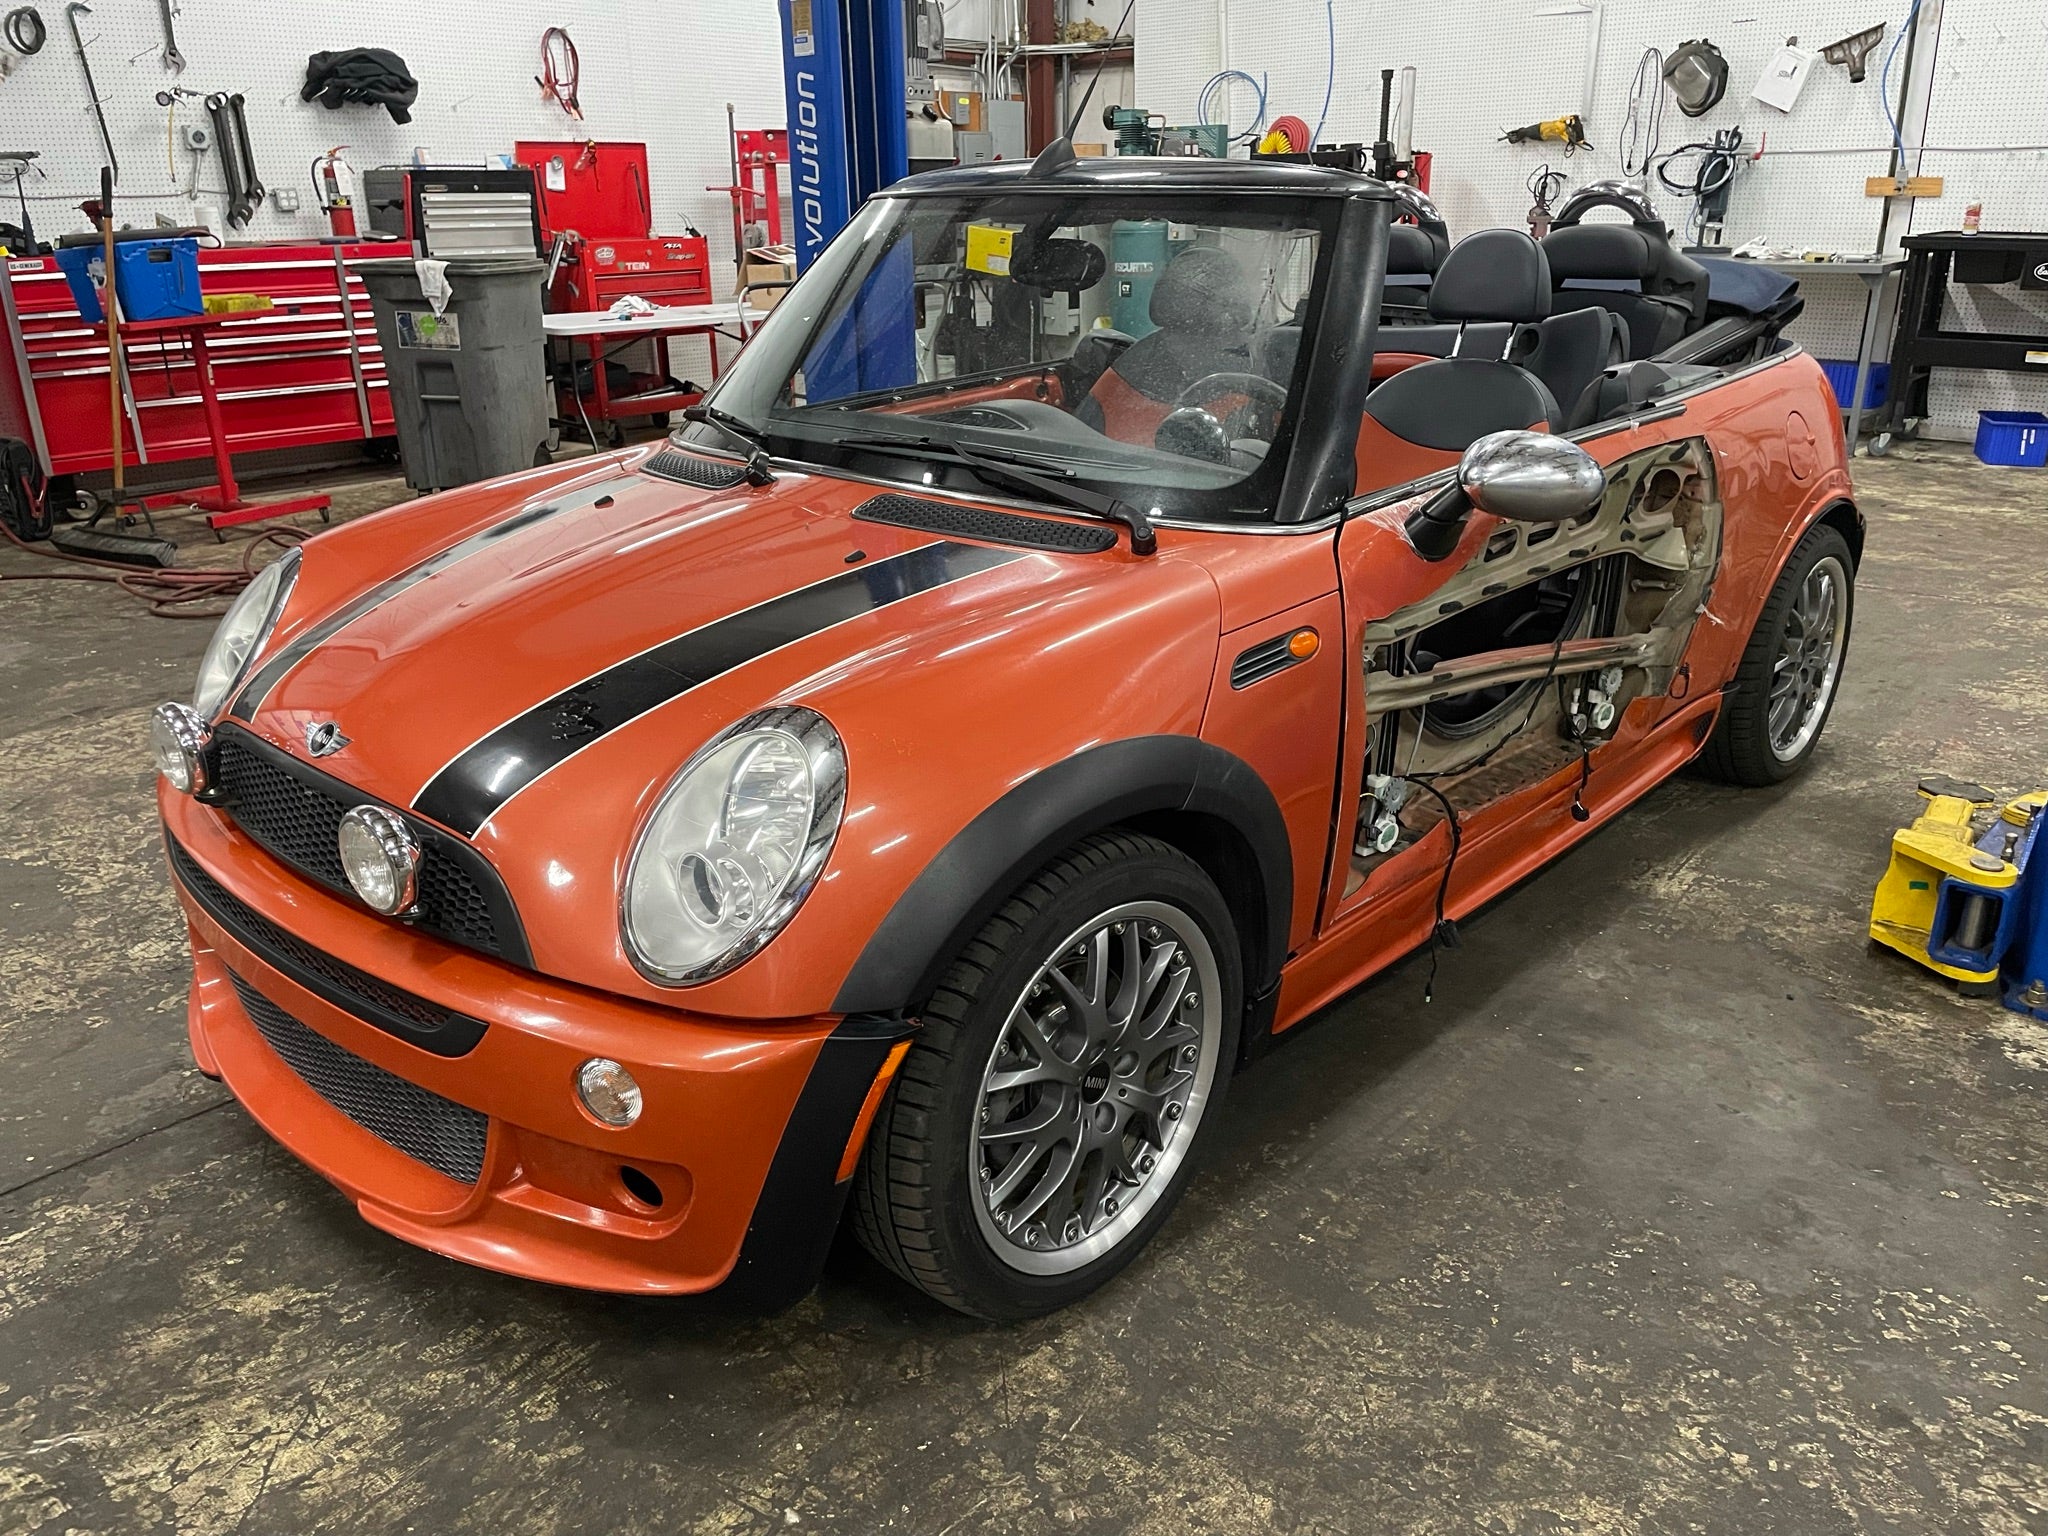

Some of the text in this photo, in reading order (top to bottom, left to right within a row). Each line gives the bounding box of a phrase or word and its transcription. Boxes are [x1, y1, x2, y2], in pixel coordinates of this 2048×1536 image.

[797, 71, 824, 260] volution
[625, 261, 650, 270] TEIN
[1084, 1075, 1107, 1089] MINI
